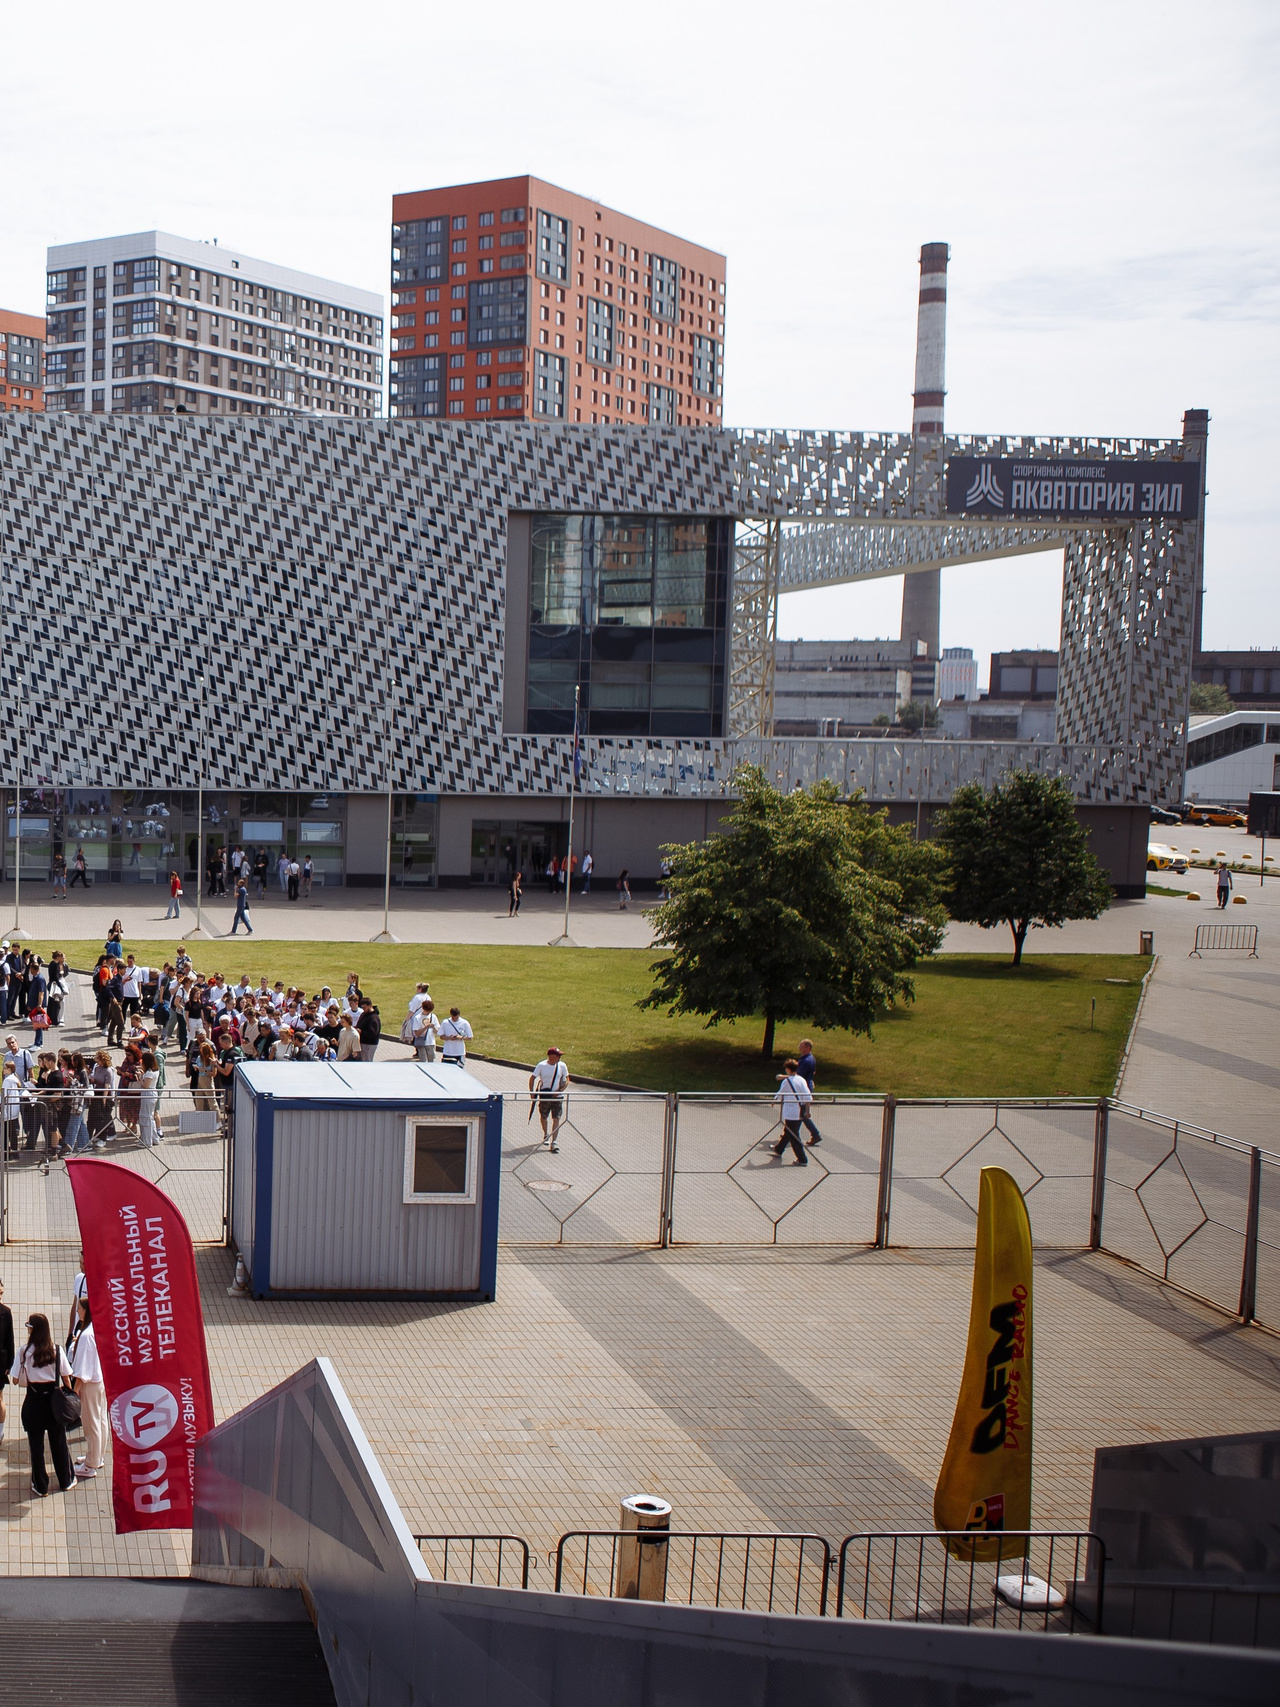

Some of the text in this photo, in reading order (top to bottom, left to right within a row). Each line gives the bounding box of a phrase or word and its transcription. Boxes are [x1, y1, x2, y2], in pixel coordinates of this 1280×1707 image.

[1011, 480, 1183, 512] АКВАТОРИЯ ЗИЛ
[1013, 465, 1105, 479] СПОРТИВНЫЙ КОМПЛЕКС
[107, 1277, 133, 1367] РУССКИЙ
[119, 1204, 153, 1364] МУЗЫКАЛЬНЫЙ
[145, 1216, 176, 1360] ТЕЛЕКАНАЛ
[180, 1377, 197, 1443] МУЗЫКУ!
[129, 1400, 172, 1514] RU TV
